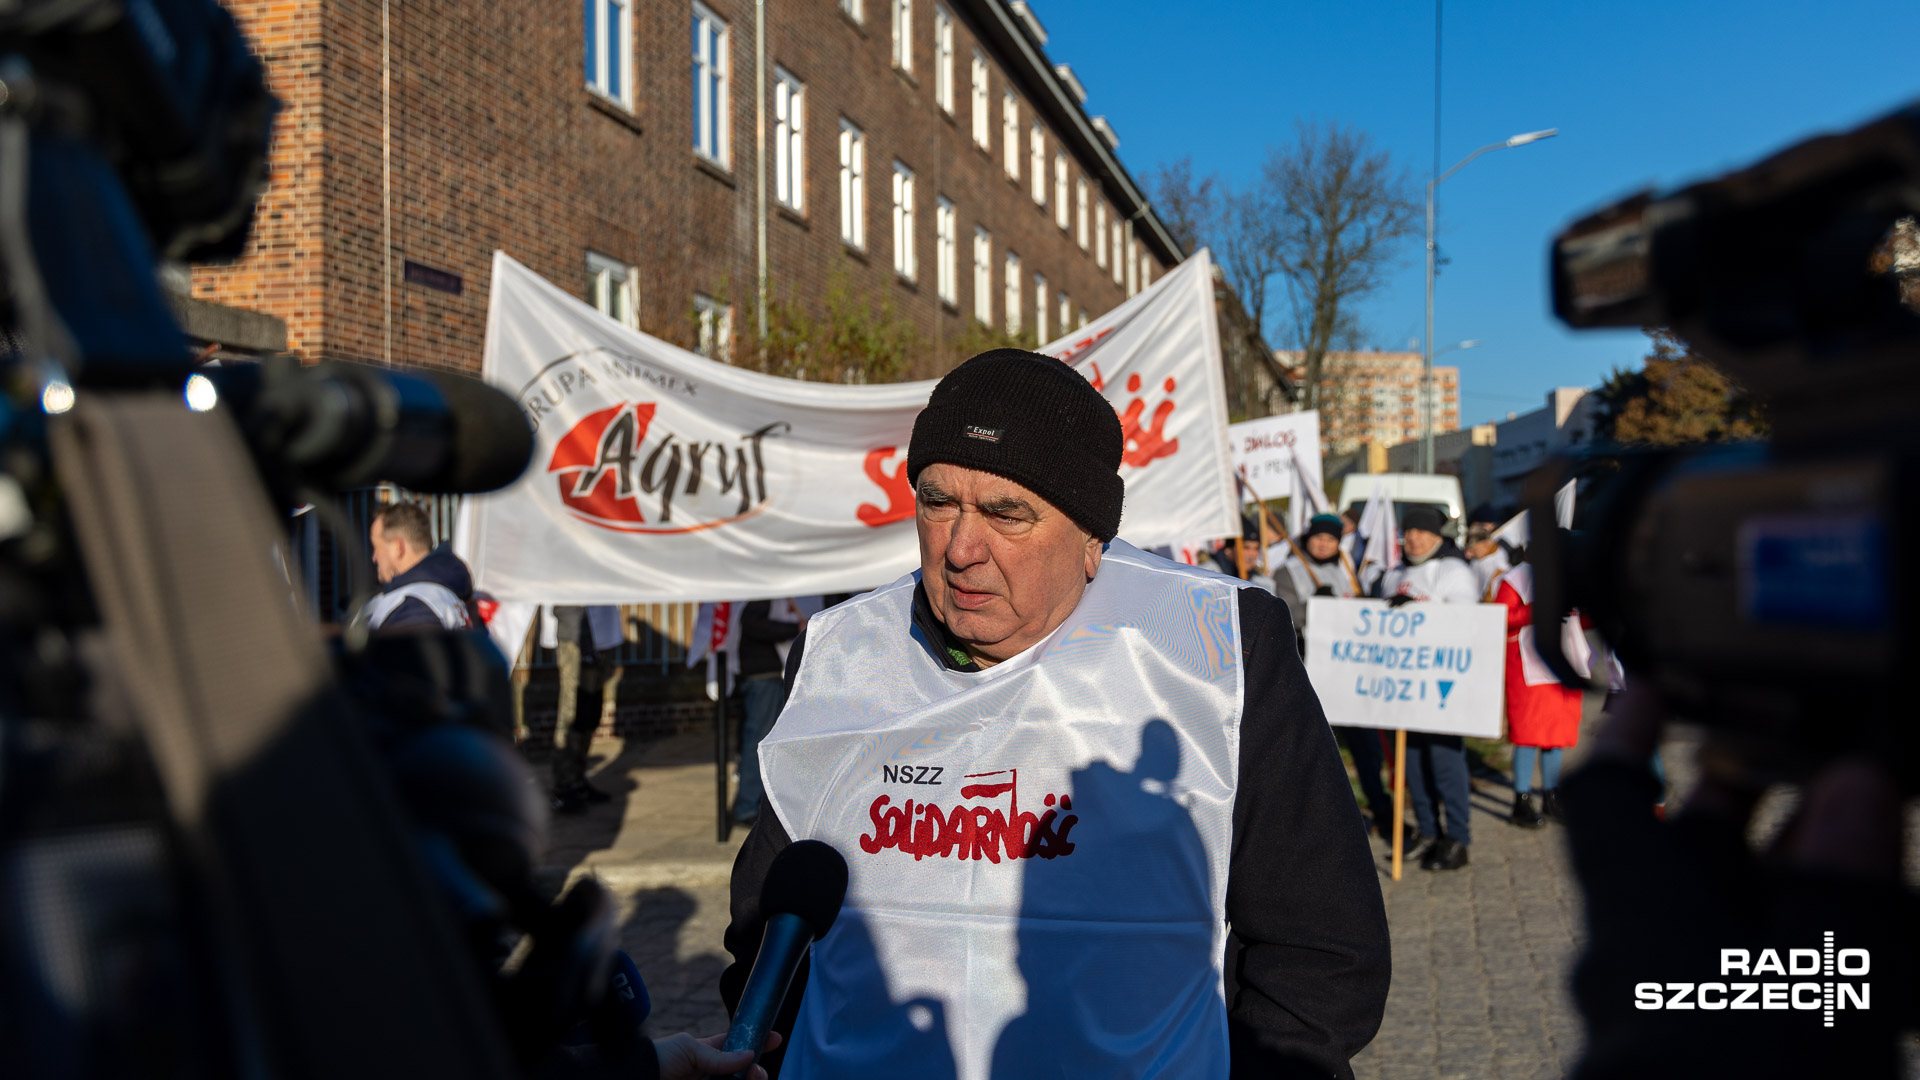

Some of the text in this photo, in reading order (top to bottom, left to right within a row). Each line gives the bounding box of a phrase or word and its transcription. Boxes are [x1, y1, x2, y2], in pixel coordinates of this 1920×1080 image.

[1353, 607, 1426, 638] STOP
[1331, 640, 1473, 673] KRZYWDZENIU
[883, 764, 944, 785] NSZZ
